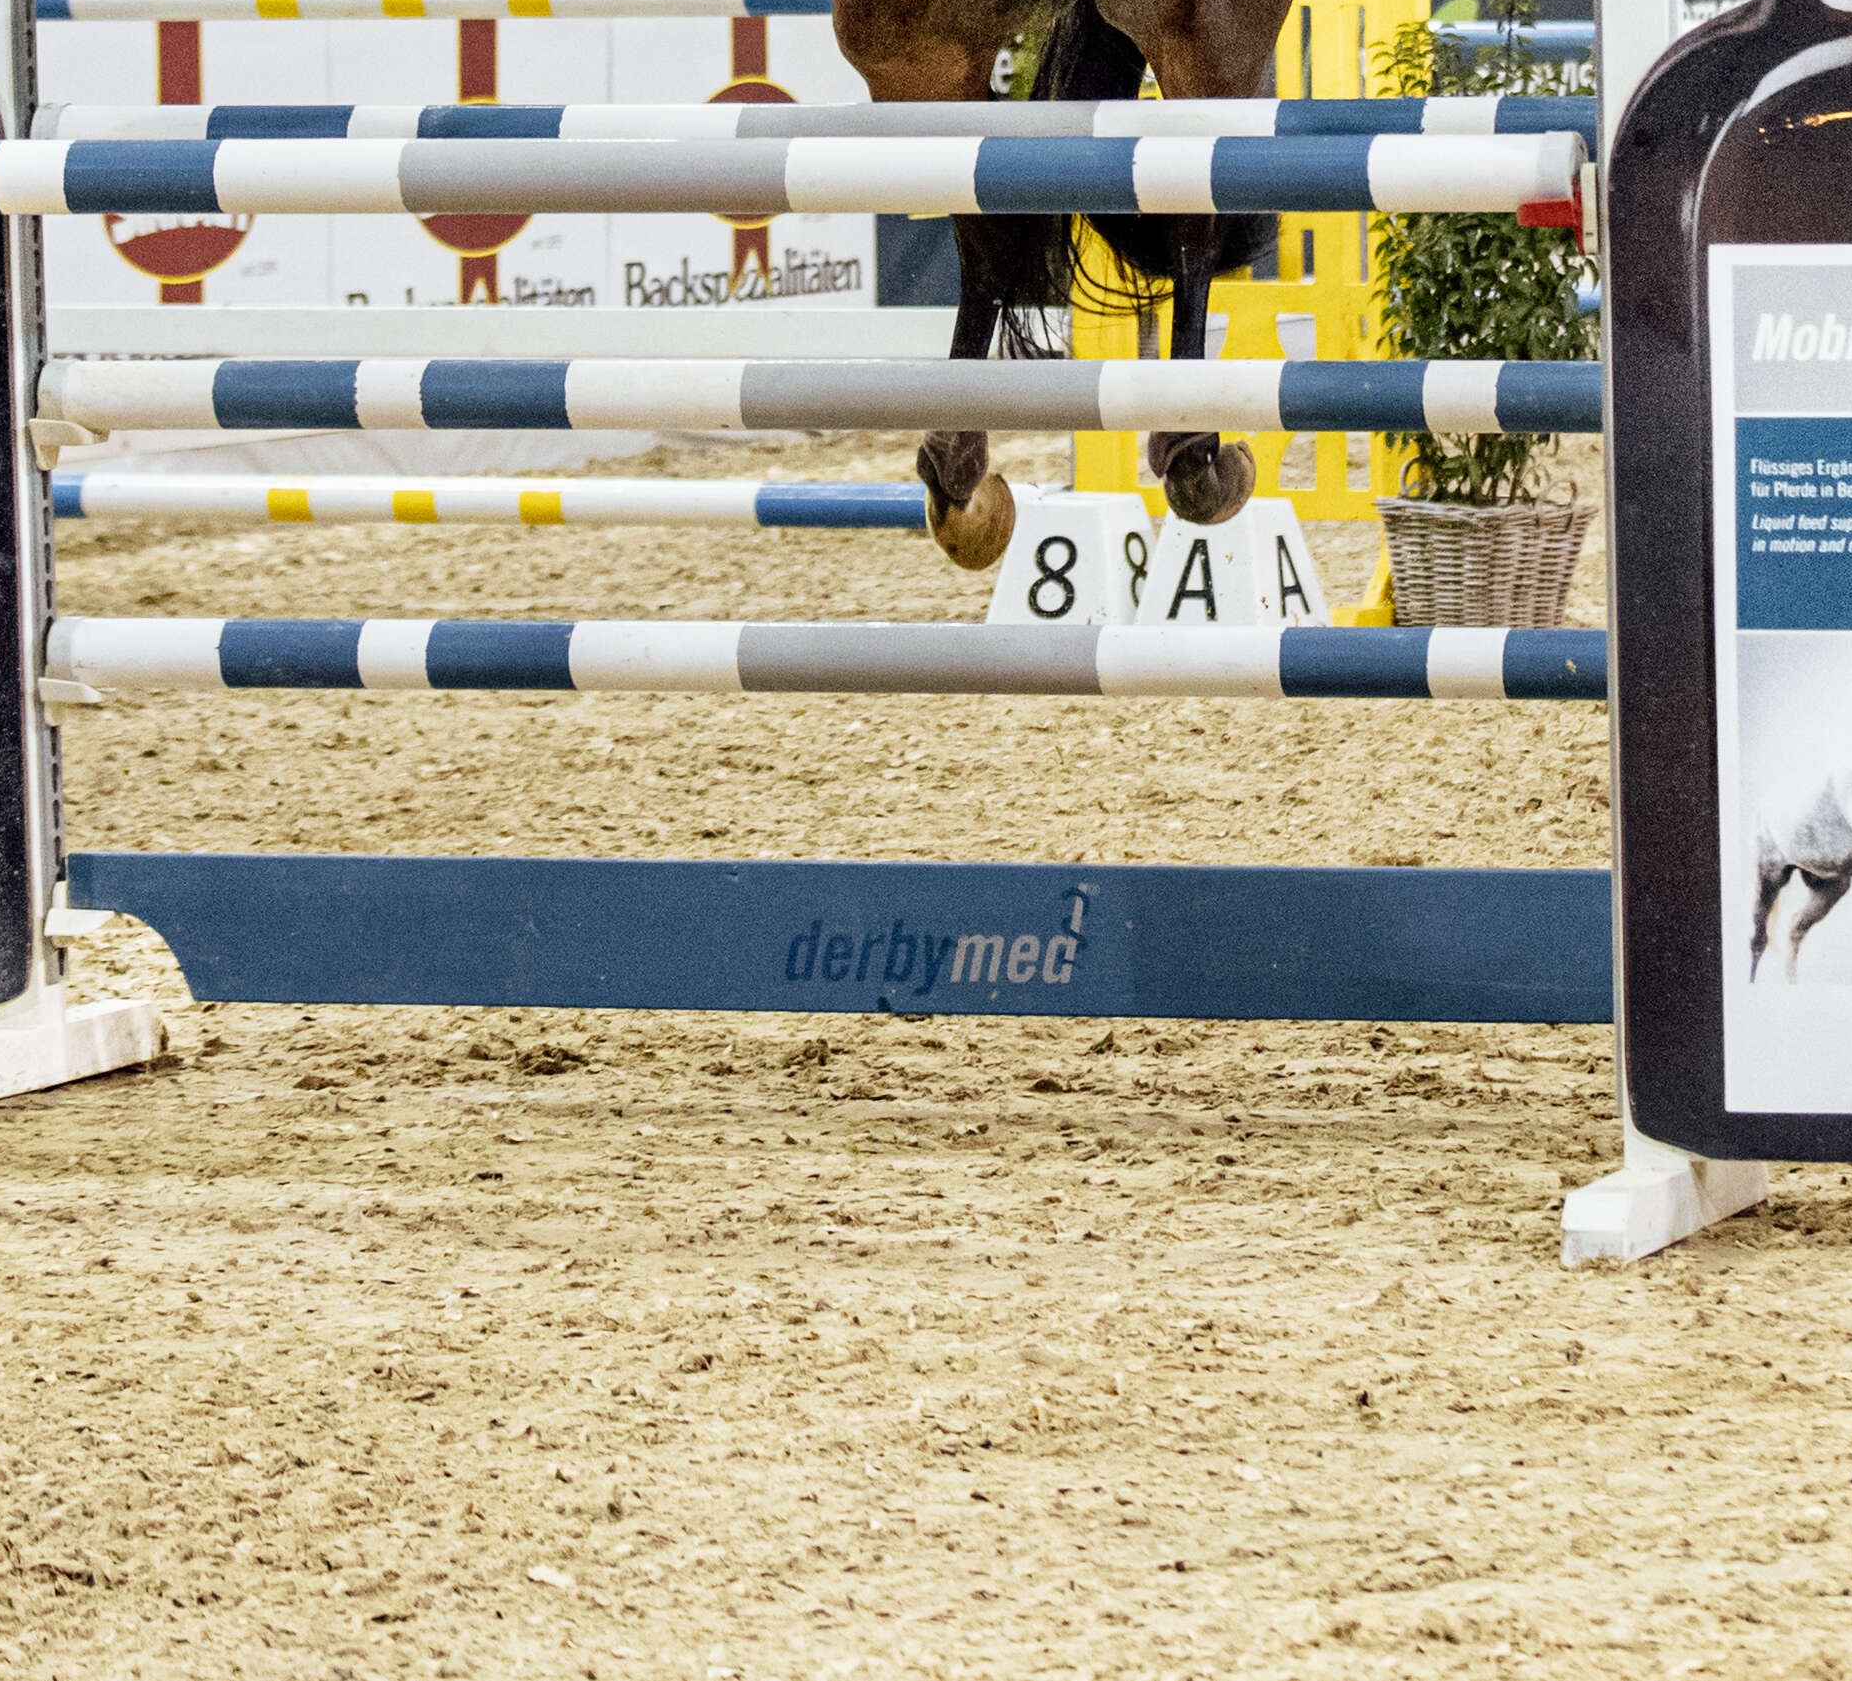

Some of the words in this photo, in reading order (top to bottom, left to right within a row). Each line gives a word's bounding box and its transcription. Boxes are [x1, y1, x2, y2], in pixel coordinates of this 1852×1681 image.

[1750, 458, 1814, 479] Flüssiges
[1750, 481, 1771, 498] für
[1773, 481, 1817, 498] Pferde
[1820, 482, 1834, 498] in
[1751, 514, 1795, 532] Liquid
[1797, 514, 1827, 531] feed
[1751, 538, 1766, 553] in
[1769, 538, 1815, 553] motion
[1818, 537, 1846, 553] and
[1028, 536, 1078, 620] 8
[1166, 539, 1218, 621] A
[1276, 535, 1311, 618] A
